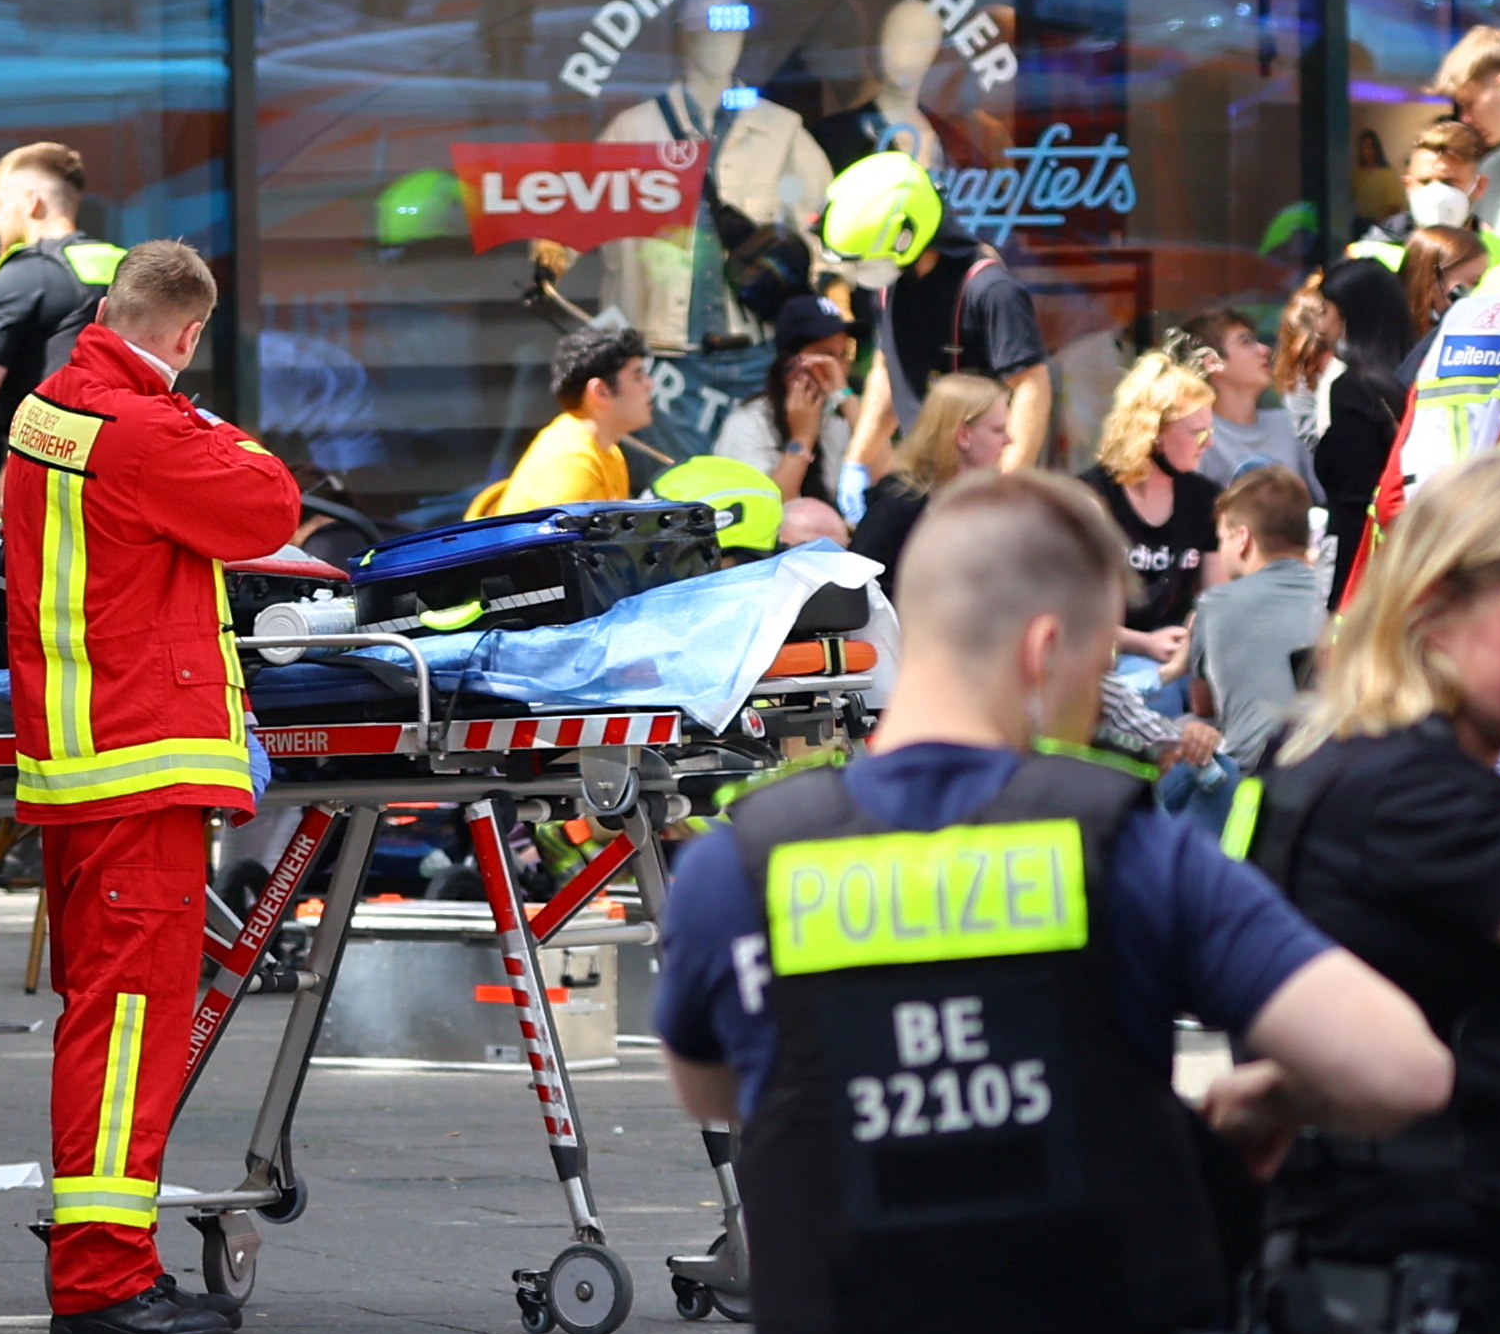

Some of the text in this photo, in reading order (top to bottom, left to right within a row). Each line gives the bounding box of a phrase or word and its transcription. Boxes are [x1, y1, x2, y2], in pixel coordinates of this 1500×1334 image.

[238, 832, 316, 951] FEUERWEHR
[789, 842, 1069, 947] POLIZEI
[891, 996, 990, 1070] BE
[847, 1060, 1053, 1145] 32105
